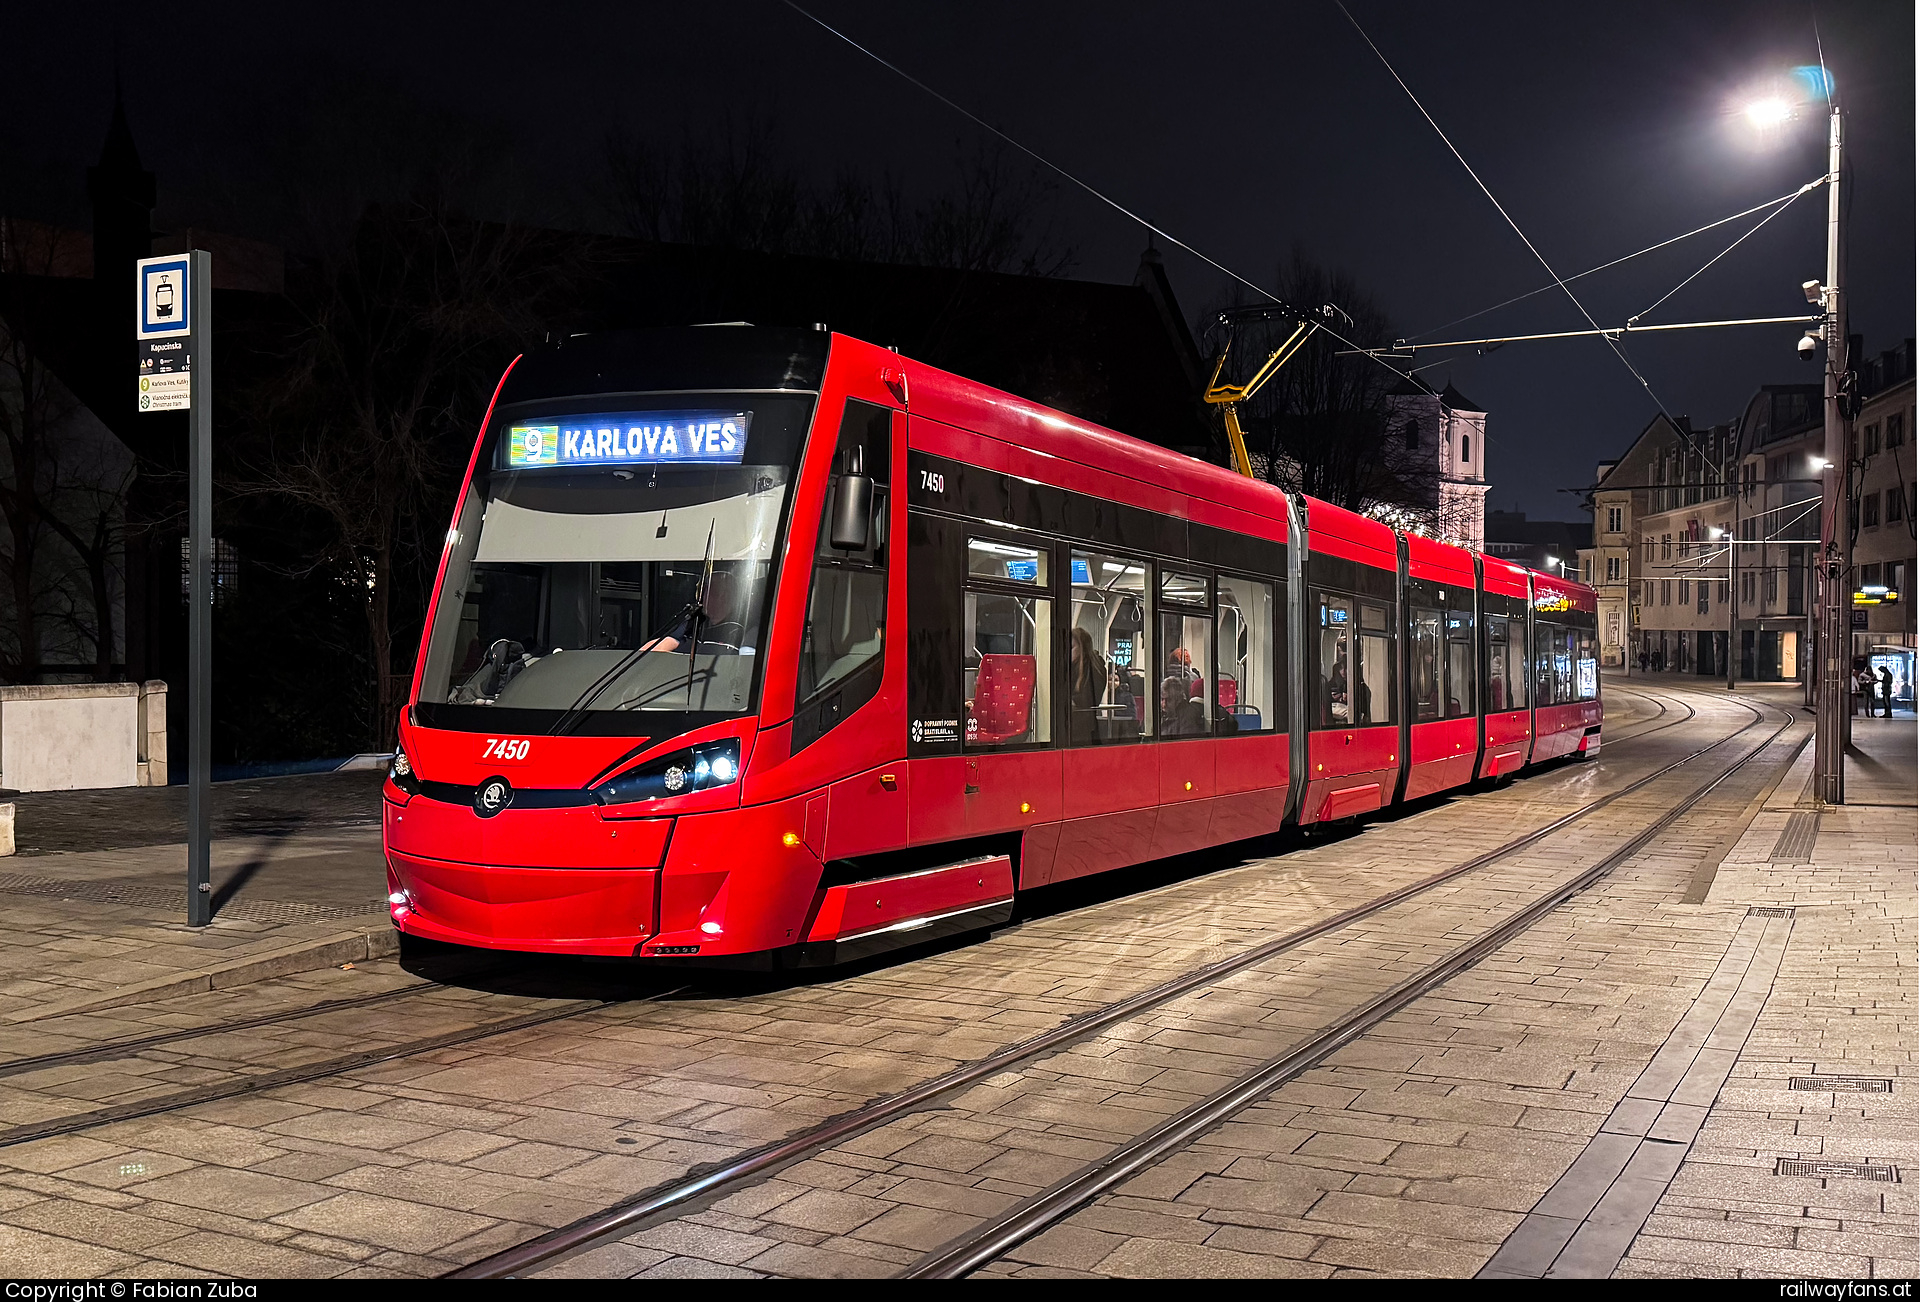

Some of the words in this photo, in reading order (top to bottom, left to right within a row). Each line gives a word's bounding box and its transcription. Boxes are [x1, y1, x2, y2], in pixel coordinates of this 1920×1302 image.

[525, 430, 543, 462] 9
[564, 425, 678, 458] KARLOVA
[688, 422, 737, 453] VES
[920, 470, 945, 493] 7450
[482, 738, 530, 760] 7450
